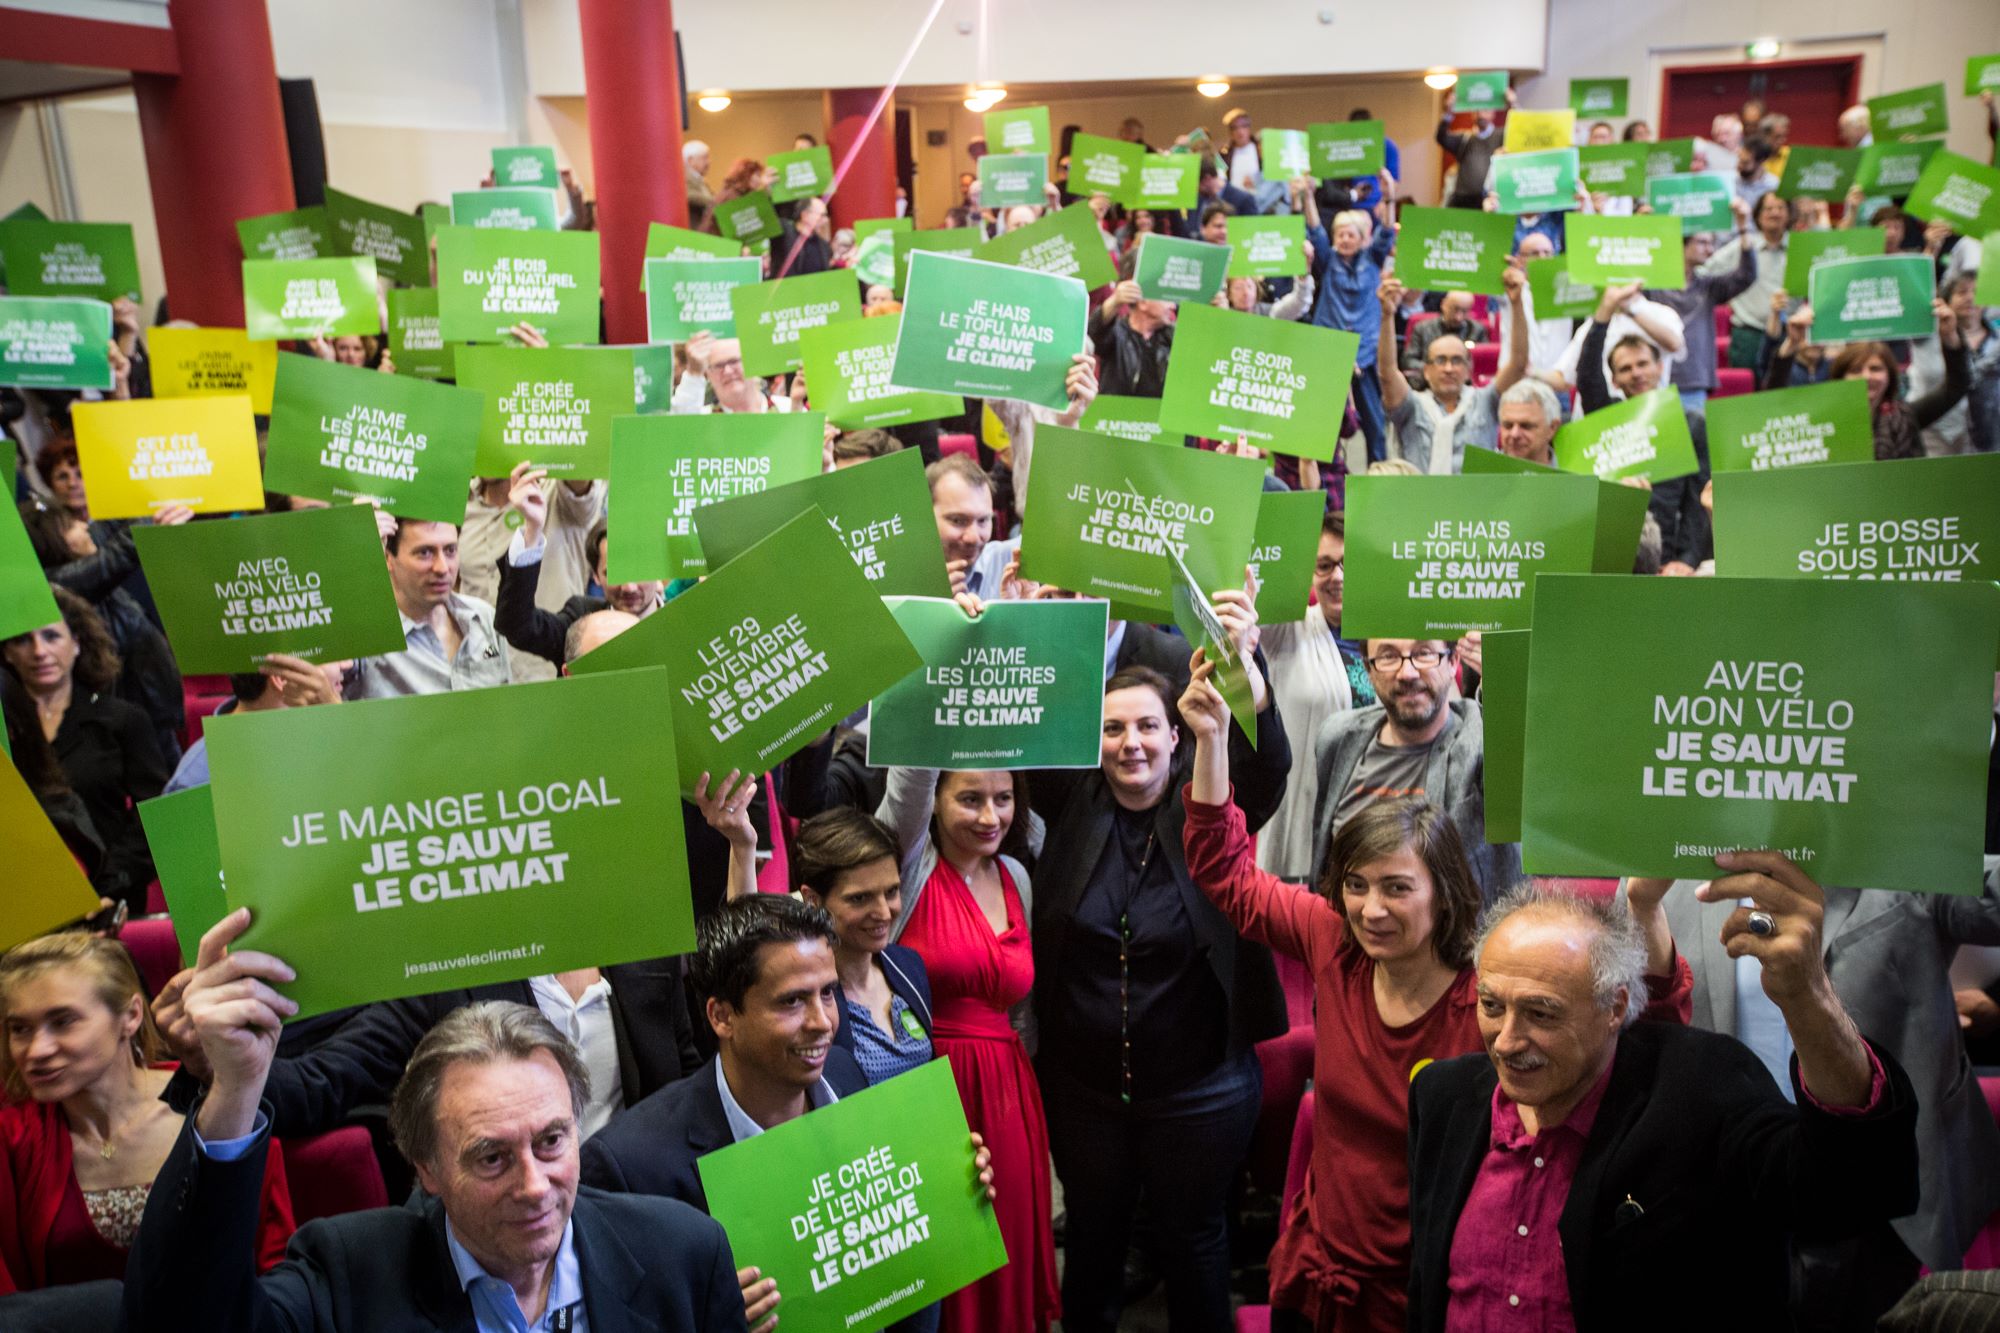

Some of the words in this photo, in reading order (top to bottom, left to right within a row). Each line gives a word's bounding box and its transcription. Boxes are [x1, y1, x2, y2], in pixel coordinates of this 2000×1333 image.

[494, 258, 510, 272] JE
[513, 259, 547, 272] BOIS
[1424, 259, 1437, 269] LE
[1438, 260, 1480, 272] CLIMAT
[1442, 251, 1478, 262] SAUVE
[463, 270, 483, 284] DU
[487, 272, 512, 285] VIN
[515, 272, 577, 288] NATUREL
[487, 286, 505, 299] JE
[507, 286, 555, 300] SAUVE
[482, 299, 500, 312] LE
[502, 299, 560, 314] CLIMAT
[759, 311, 772, 325] JE
[773, 308, 801, 322] VOTE
[968, 299, 987, 315] JE
[992, 303, 1031, 322] HAIS
[774, 320, 788, 332] JE
[790, 315, 828, 331] SAUVE
[940, 312, 958, 328] LE
[1011, 323, 1054, 343] MAIS
[771, 332, 787, 345] LE
[955, 332, 975, 348] JE
[978, 335, 1034, 356] SAUVE
[834, 351, 850, 366] JE
[852, 345, 885, 362] BOIS
[946, 346, 966, 362] LE
[969, 351, 1036, 372] CLIMAT
[1231, 347, 1252, 363] CE
[1254, 351, 1292, 371] SOIR
[840, 363, 860, 378] DU
[850, 374, 867, 388] JE
[1210, 360, 1229, 375] JE
[1232, 363, 1273, 381] PEUX
[1276, 371, 1307, 390] PAS
[512, 382, 530, 398] JE
[534, 379, 574, 399] CRÉE
[847, 389, 865, 403] LE
[1217, 377, 1236, 392] JE
[1239, 380, 1293, 403] SAUVE
[498, 398, 518, 413] DE
[522, 399, 590, 415] L'EMPLOI
[1209, 390, 1228, 407] LE
[1231, 394, 1295, 419] CLIMAT
[347, 404, 406, 430] J'AIME
[507, 414, 525, 429] JE
[528, 415, 582, 430] SAUVE
[1762, 413, 1811, 431] J'AIME
[137, 437, 166, 450] CET
[171, 433, 198, 449] ÉTÉ
[321, 416, 353, 436] LES
[357, 425, 427, 450] KOALAS
[503, 429, 521, 445] LE
[523, 429, 589, 446] CLIMAT
[1741, 431, 1767, 448] LES
[1770, 422, 1835, 445] LOUTRES
[132, 451, 151, 465] JE
[154, 449, 207, 464] SAUVE
[328, 436, 349, 453] JE
[352, 440, 415, 464] SAUVE
[1752, 456, 1769, 470] LE
[1771, 449, 1830, 467] CLIMAT
[1755, 444, 1773, 458] JE
[1775, 439, 1823, 454] SAUVE
[129, 465, 148, 480] LE
[151, 461, 213, 478] CLIMAT
[320, 450, 342, 468] LE
[344, 455, 419, 482] CLIMAT
[669, 459, 691, 477] JE
[697, 457, 770, 475] PRENDS
[673, 478, 695, 497] LE
[700, 474, 767, 496] MÉTRO
[1067, 484, 1090, 503] JE
[1095, 488, 1145, 513] VOTE
[1150, 495, 1215, 526] ÉCOLO
[666, 518, 689, 536] LE
[851, 513, 904, 547] D'ÉTÉ
[1089, 508, 1114, 526] JE
[1117, 513, 1186, 541] SAUVE
[1427, 521, 1452, 539] JE
[1458, 521, 1511, 539] HAIS
[1815, 523, 1849, 546] JE
[1859, 517, 1960, 544] BOSSE
[1080, 525, 1103, 545] LE
[1107, 529, 1189, 560] CLIMAT
[1392, 541, 1417, 560] LE
[1423, 541, 1481, 561] TOFU,
[1487, 541, 1545, 560] MAIS
[238, 557, 289, 578] AVEC
[1798, 548, 1878, 573] SOUS
[1887, 542, 1981, 569] LINUX
[1415, 562, 1442, 579] JE
[1446, 562, 1519, 579] SAUVE
[214, 580, 264, 600] MON
[268, 571, 321, 592] VÉLO
[1408, 582, 1434, 599] LE
[1437, 582, 1525, 599] CLIMAT
[224, 598, 249, 617] JE
[251, 591, 323, 615] SAUVE
[222, 618, 246, 635] LE
[249, 608, 333, 634] CLIMAT
[1425, 620, 1502, 631] jesauveleclimat.fr
[698, 636, 730, 667] LE
[729, 616, 761, 648] 29
[681, 613, 807, 706] NOVEMBRE
[961, 647, 1026, 666] J'AIME
[707, 689, 737, 720] JE
[733, 638, 813, 700] SAUVE
[926, 667, 963, 685] LES
[970, 667, 1056, 686] LOUTRES
[1704, 660, 1804, 692] AVEC
[710, 714, 744, 743] LE
[740, 651, 830, 723] CLIMAT
[942, 689, 968, 706] JE
[971, 687, 1039, 706] SAUVE
[935, 708, 960, 726] LE
[963, 707, 1044, 726] CLIMAT
[1653, 695, 1744, 727] MON
[1756, 691, 1854, 731] VÉLO
[756, 702, 834, 761] jesauveleclimat.fr
[951, 749, 1024, 760] jesauveleclimat.fr
[1655, 731, 1703, 762] JE
[1710, 733, 1846, 767] SAUVE
[1642, 766, 1688, 797] LE
[1695, 767, 1858, 803] CLIMAT
[281, 812, 328, 848] JE
[339, 792, 487, 840] MANGE
[497, 776, 621, 820] LOCAL
[361, 839, 411, 875] JE
[417, 819, 554, 866] SAUVE
[352, 878, 403, 912] LE
[409, 853, 570, 901] CLIMAT
[404, 943, 545, 978] jesauveleclimat.fr
[808, 1173, 835, 1204] JE
[838, 1145, 895, 1189] CRÉE
[790, 1208, 824, 1242] DE
[827, 1162, 923, 1225] L'EMPLOI
[812, 1229, 842, 1262] JE
[843, 1193, 920, 1247] SAUVE
[810, 1261, 841, 1293] LE
[842, 1215, 930, 1277] CLIMAT
[845, 1278, 926, 1329] jesauveleclimat.fr
